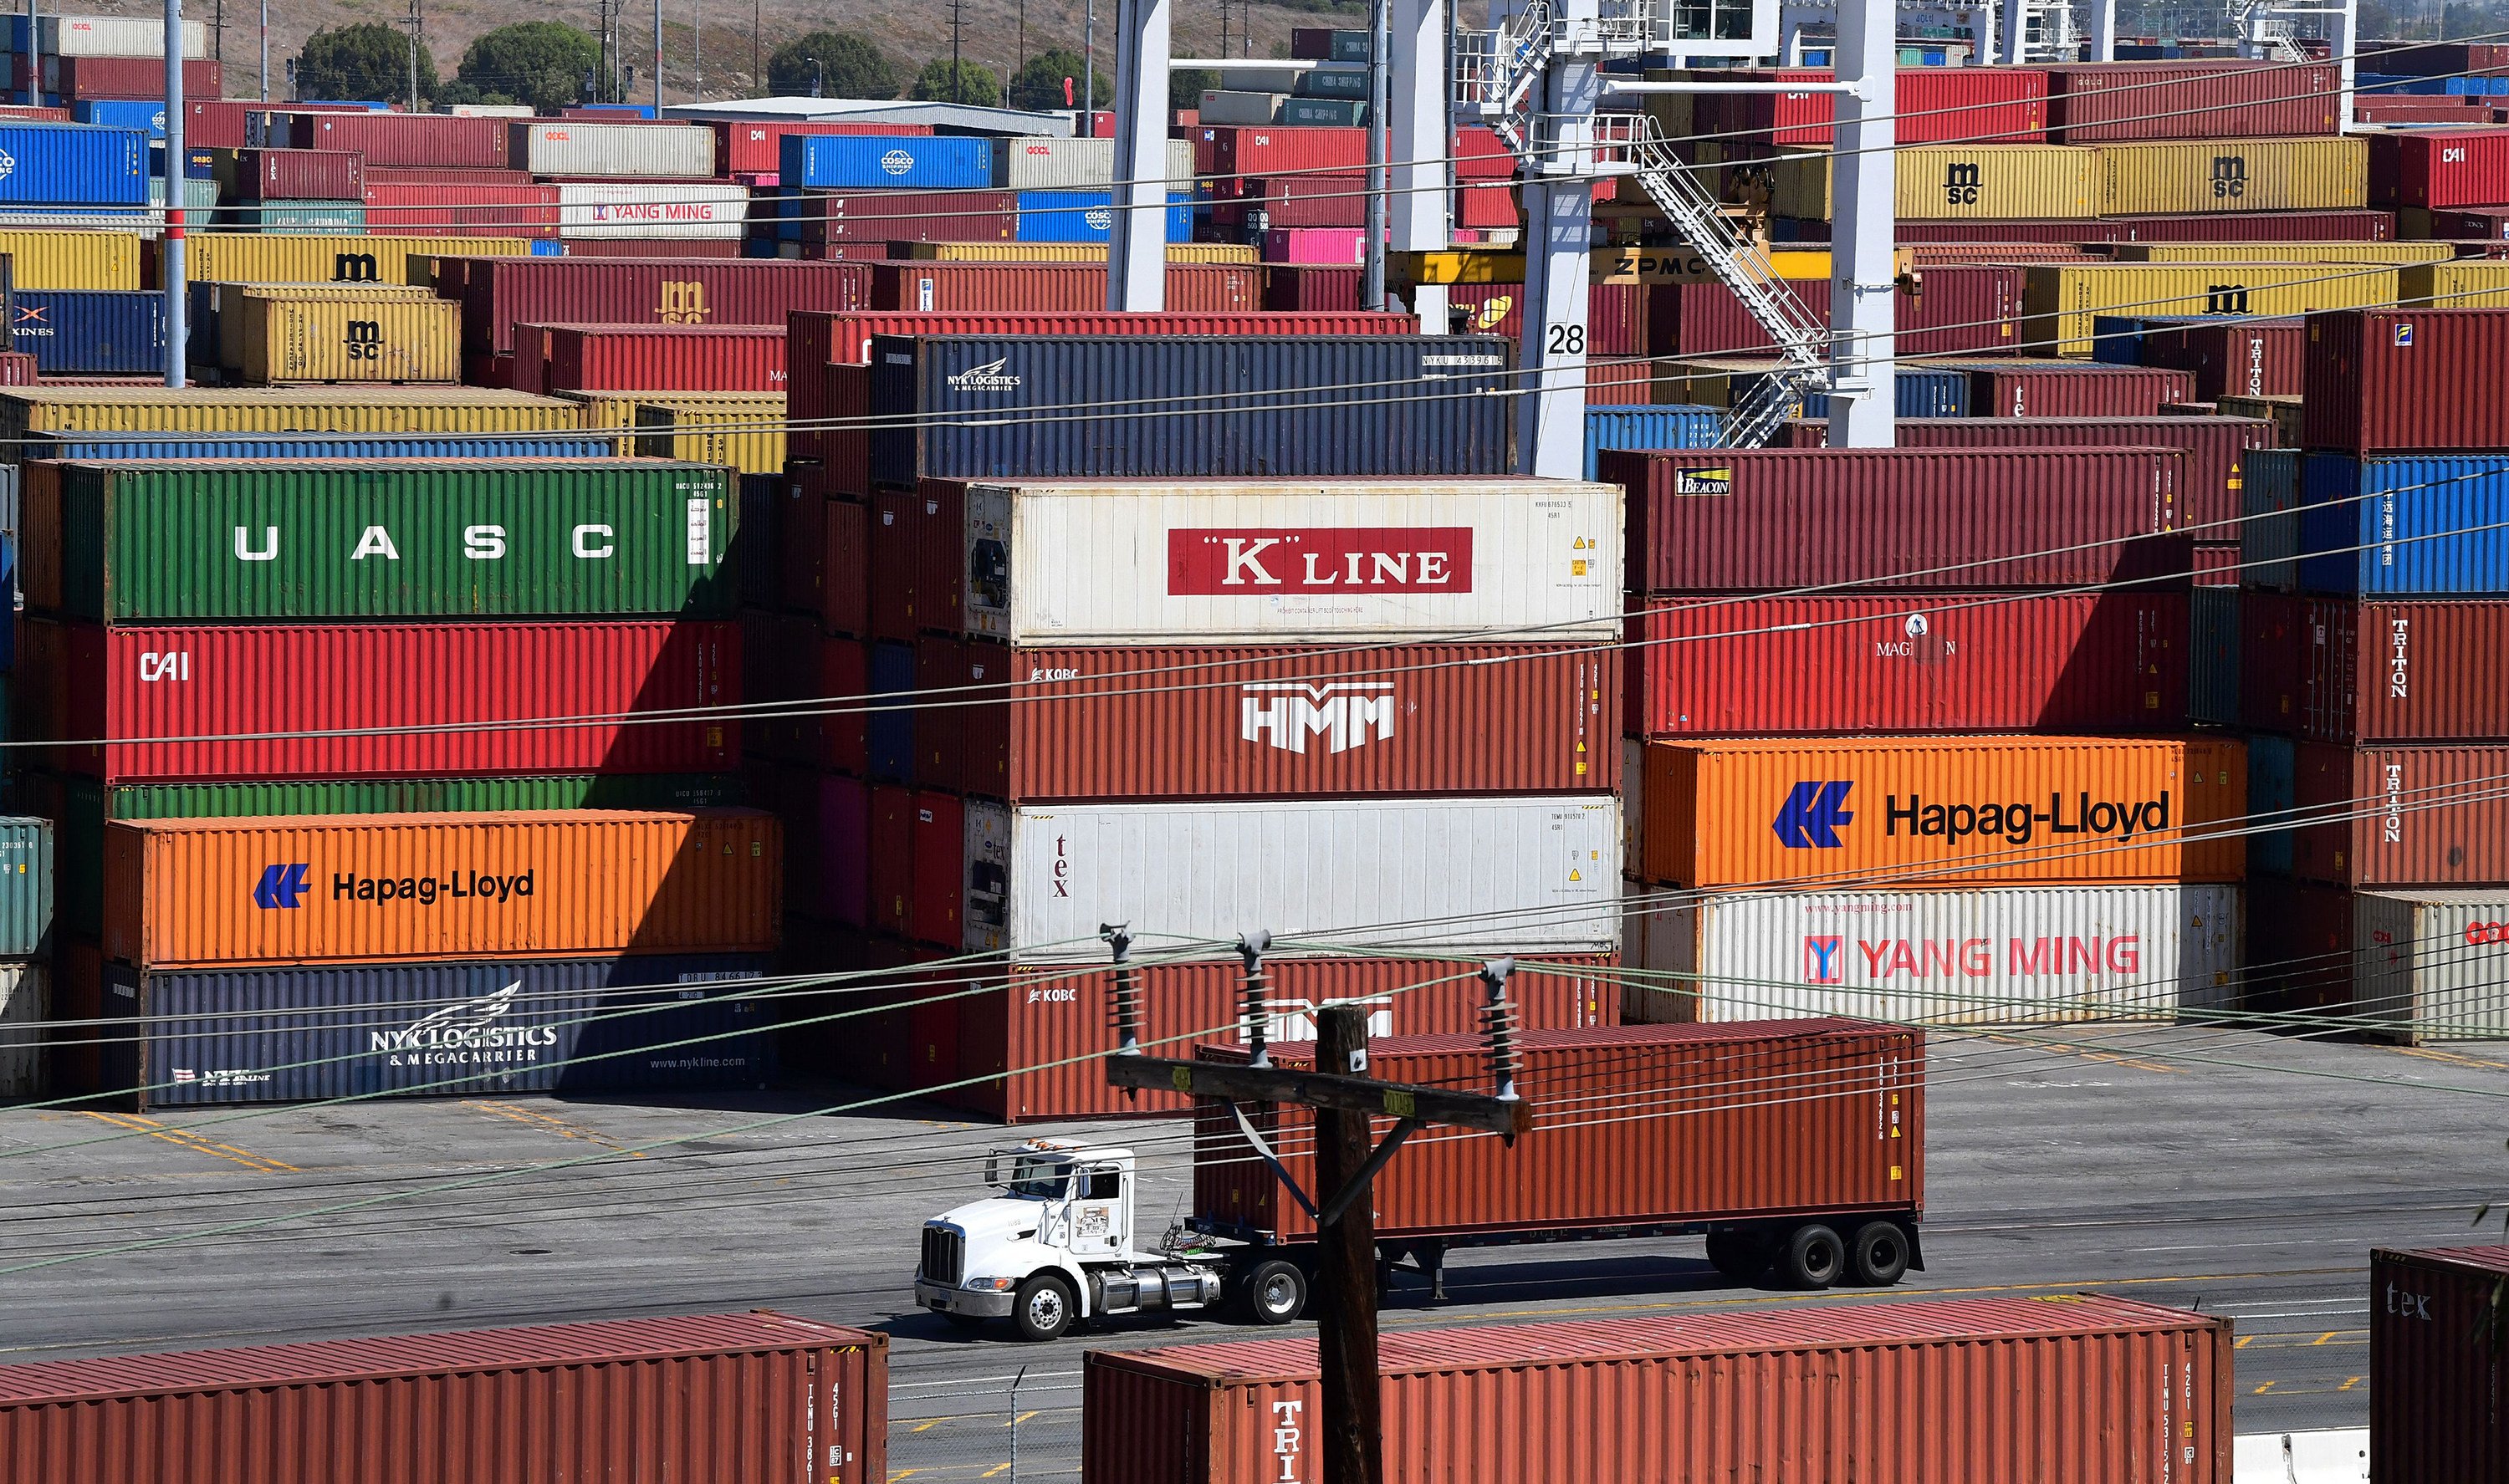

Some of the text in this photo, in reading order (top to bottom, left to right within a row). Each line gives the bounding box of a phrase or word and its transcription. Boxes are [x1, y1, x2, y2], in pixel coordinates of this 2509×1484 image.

[881, 156, 914, 165] COSCO
[2442, 148, 2465, 163] CAI
[613, 203, 712, 220] YANG MING
[1614, 258, 1706, 275] ZPMC
[1548, 324, 1584, 355] 28
[1423, 356, 1449, 365] NYKU
[2249, 339, 2262, 396] TRITON
[948, 375, 1021, 385] NYK LOGISTICS
[1684, 477, 1730, 493] BEACON
[234, 523, 615, 562] UASC
[1301, 551, 1452, 585] LINE
[140, 651, 189, 681] CAI
[2390, 619, 2408, 698] TRITON
[1242, 681, 1395, 754] HMM
[1887, 790, 2169, 845] Hapag-Lloyd
[993, 839, 1005, 860] tex
[1052, 833, 1069, 899] tex
[334, 868, 534, 905] Hapag-Lloyd
[1804, 900, 1913, 915] www.yangming.com
[1857, 936, 2139, 978] YANG MING
[1043, 988, 1076, 1002] KOBC
[370, 1026, 558, 1052] NYK LOGISTICS
[389, 1049, 537, 1067] & MEGACARRIER
[650, 1057, 746, 1070] www.nykline.com
[2386, 1280, 2432, 1322] tex
[1272, 1400, 1302, 1484] TRI
